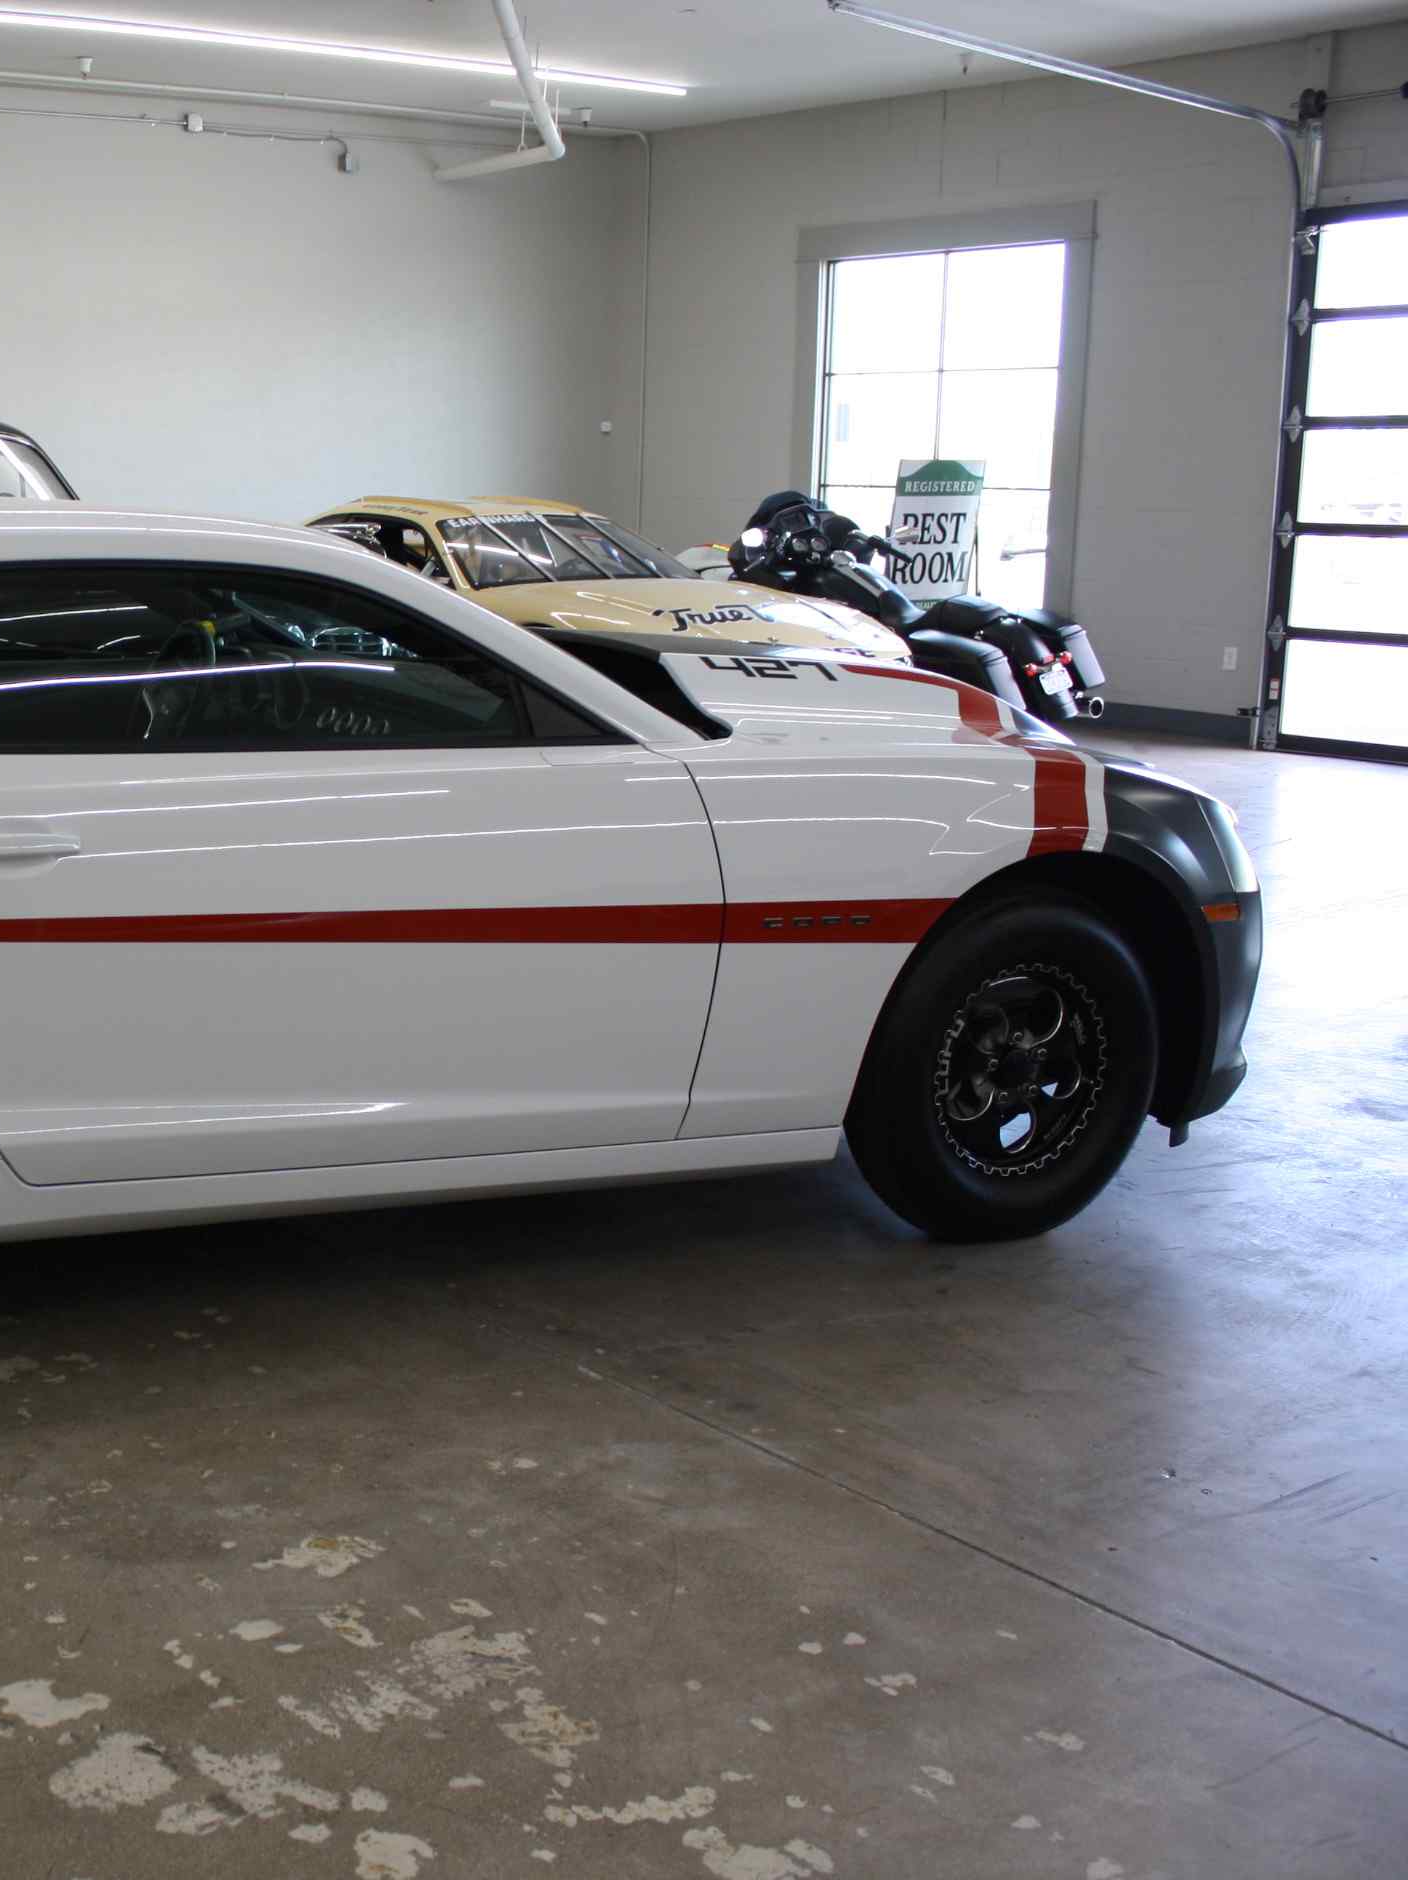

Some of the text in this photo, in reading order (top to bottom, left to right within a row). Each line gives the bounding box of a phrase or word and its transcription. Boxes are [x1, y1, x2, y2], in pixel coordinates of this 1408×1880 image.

[905, 480, 976, 493] REGISTERED
[892, 552, 968, 584] ROOM
[698, 655, 839, 682] 427
